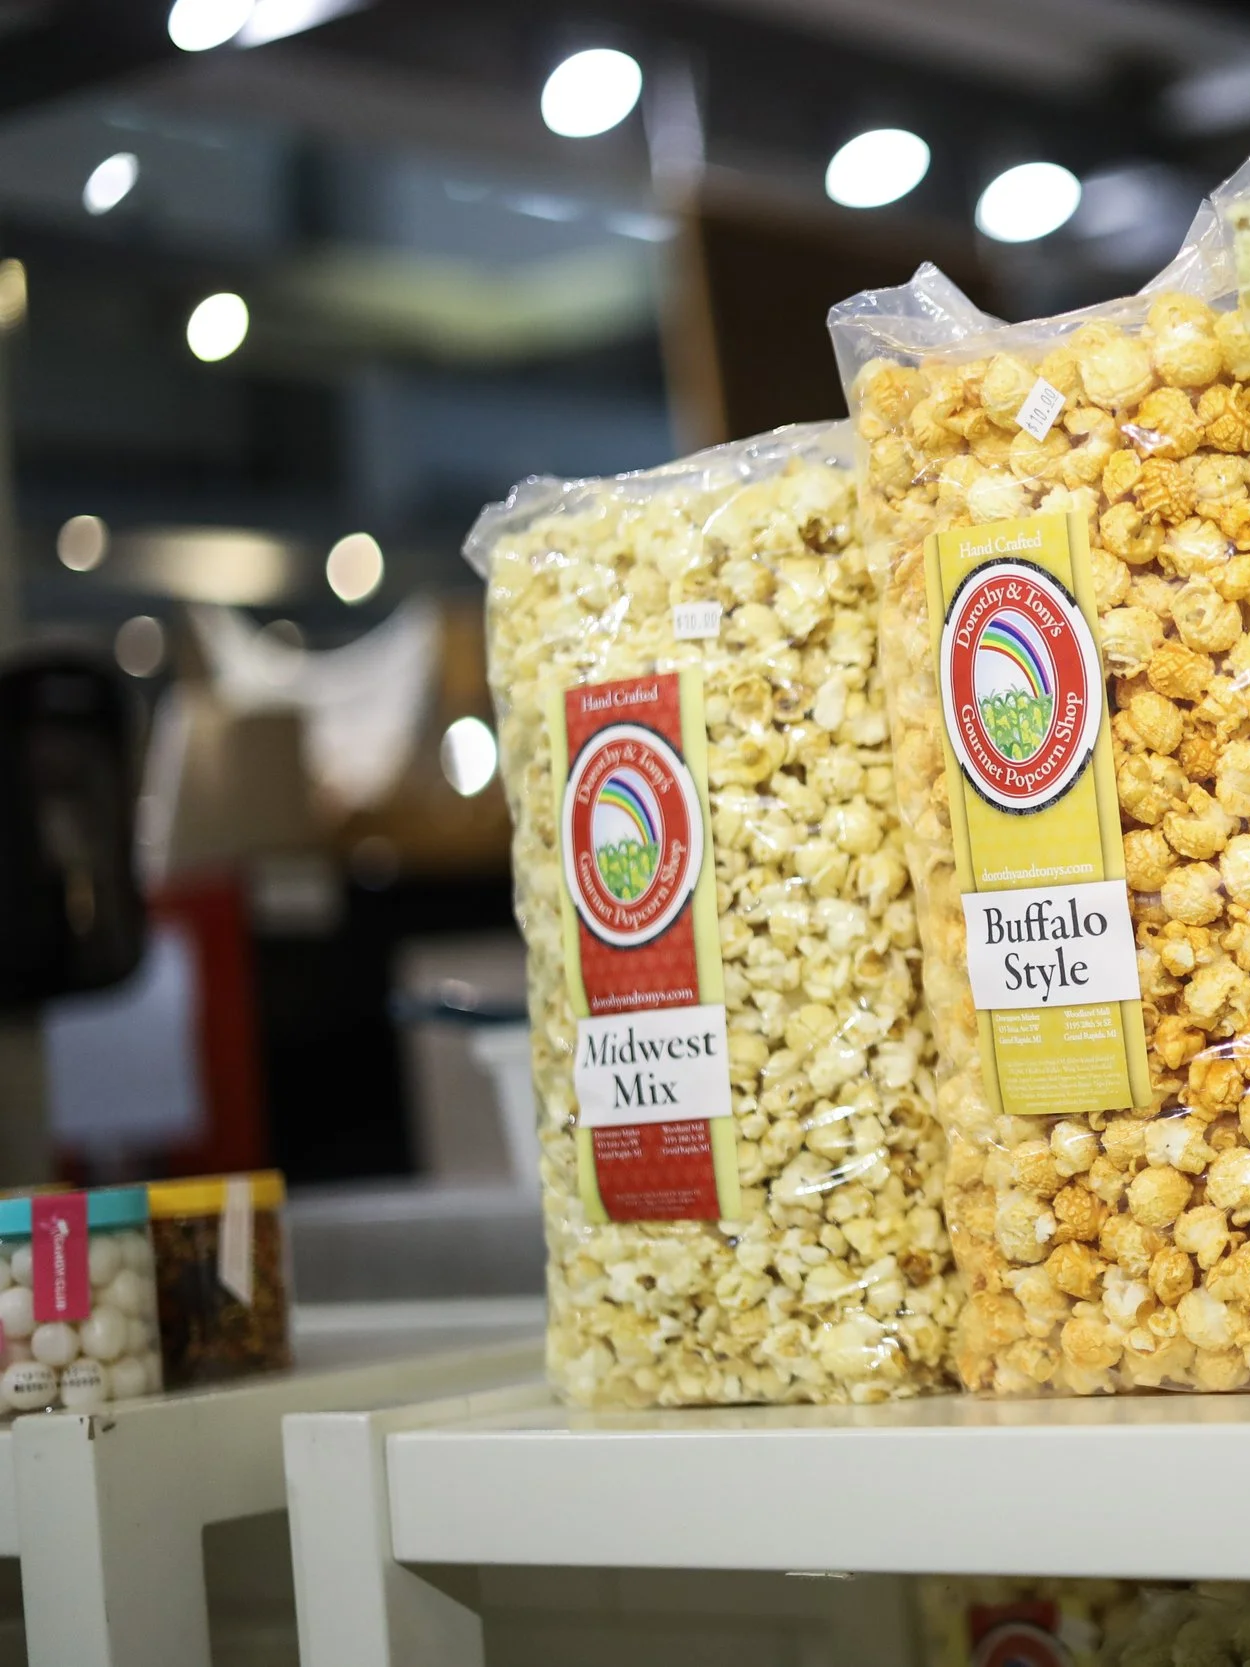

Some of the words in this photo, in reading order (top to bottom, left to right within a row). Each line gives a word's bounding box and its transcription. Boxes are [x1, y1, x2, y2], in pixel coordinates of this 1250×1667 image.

[960, 541, 993, 558] Hand
[994, 531, 1042, 554] Crafted
[956, 584, 1005, 650] Dorothy
[1006, 582, 1022, 599] &
[1023, 584, 1063, 639] Tony's
[581, 692, 612, 712] Hand
[613, 684, 659, 705] Crafted
[960, 703, 1004, 780] Gourmet
[1004, 745, 1065, 792] Popcorn
[1056, 691, 1084, 743] Shop
[577, 746, 622, 805] Dorothy
[623, 743, 637, 762] &
[639, 746, 675, 795] Tony's
[578, 851, 613, 919] Gourmet
[615, 887, 669, 930] Popcorn
[661, 838, 687, 888] Shop
[982, 863, 1095, 883] dorothyandtonys.com
[982, 897, 1108, 945] Buffalo
[1004, 946, 1090, 1002] Style
[583, 1026, 718, 1069] Midwest
[613, 1071, 680, 1109] Mix
